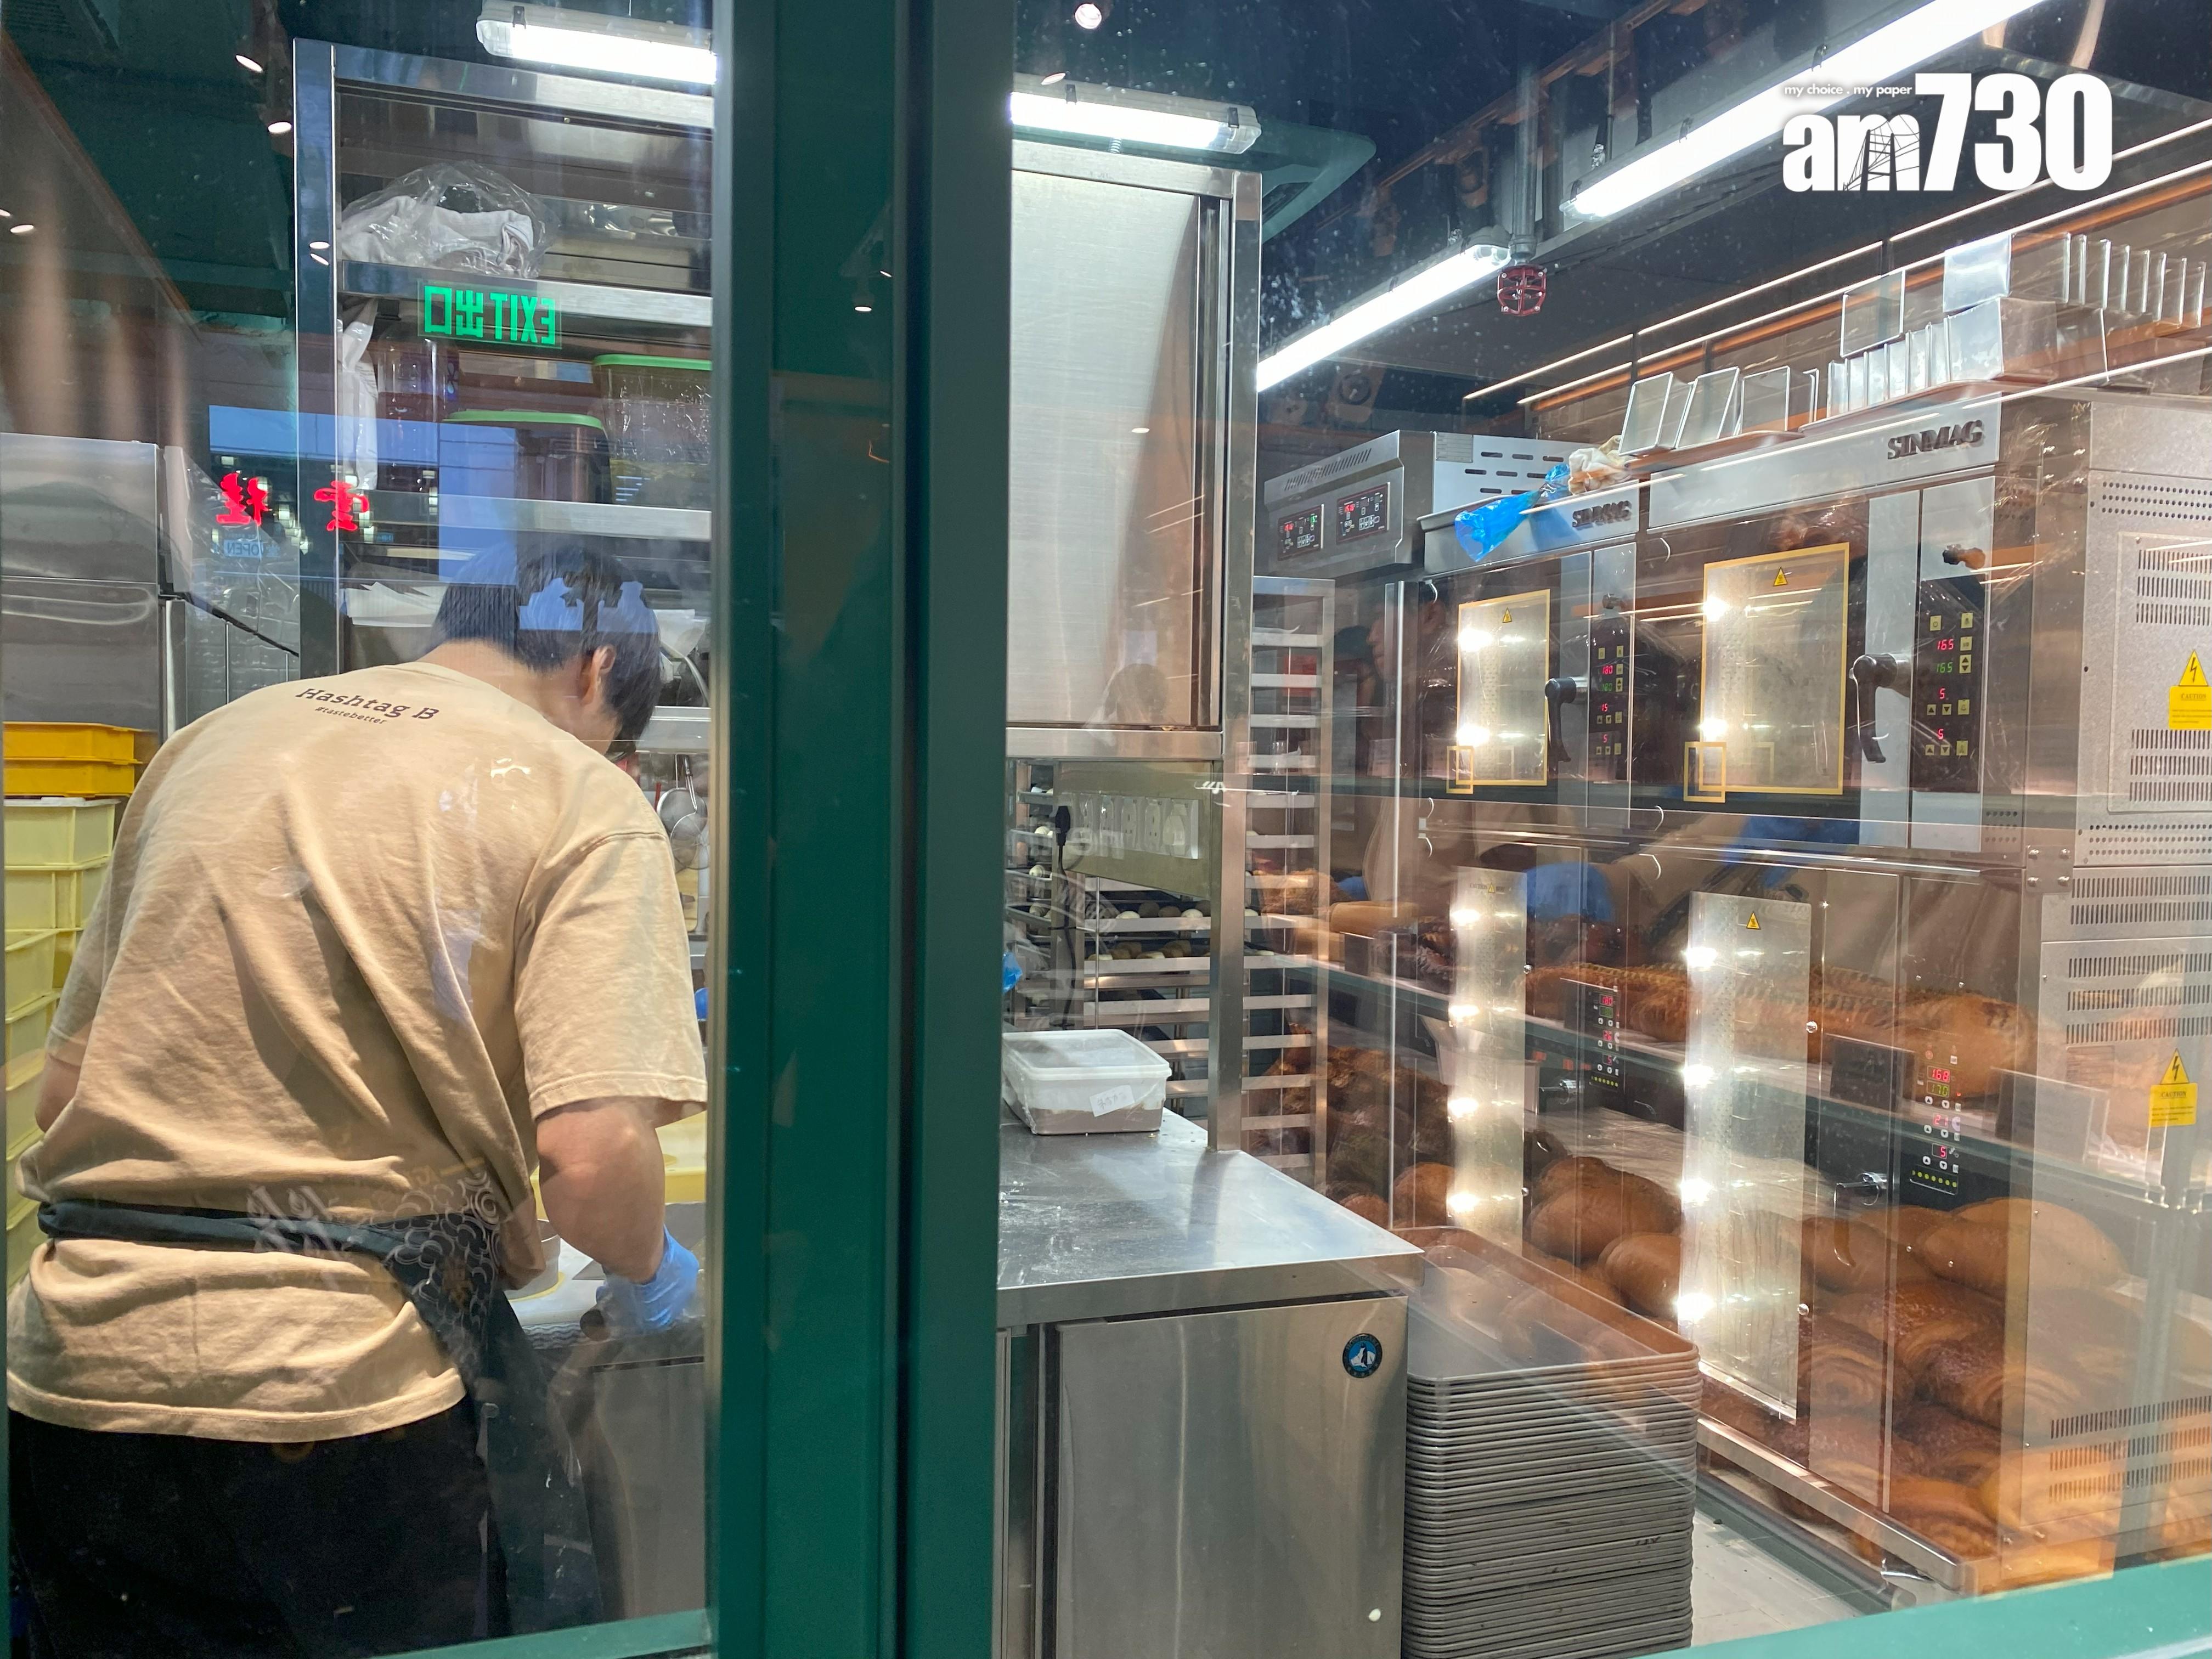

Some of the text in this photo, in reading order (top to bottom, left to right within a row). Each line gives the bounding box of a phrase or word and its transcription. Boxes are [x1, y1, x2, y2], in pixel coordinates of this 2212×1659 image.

[1887, 419, 1984, 460] SINMAG
[1937, 639, 1954, 651] 165
[1602, 665, 1613, 675] 180
[1937, 662, 1953, 673] 165
[1939, 688, 1945, 699] 5
[295, 688, 440, 720] Hashtag B
[1601, 703, 1609, 712] 15
[314, 706, 387, 725] #tastebetter
[1603, 734, 1608, 743] 5
[1938, 728, 1944, 740] 5
[1932, 1069, 1949, 1081] 168
[1932, 1085, 1948, 1096] 170
[1940, 1146, 1946, 1158] 5
